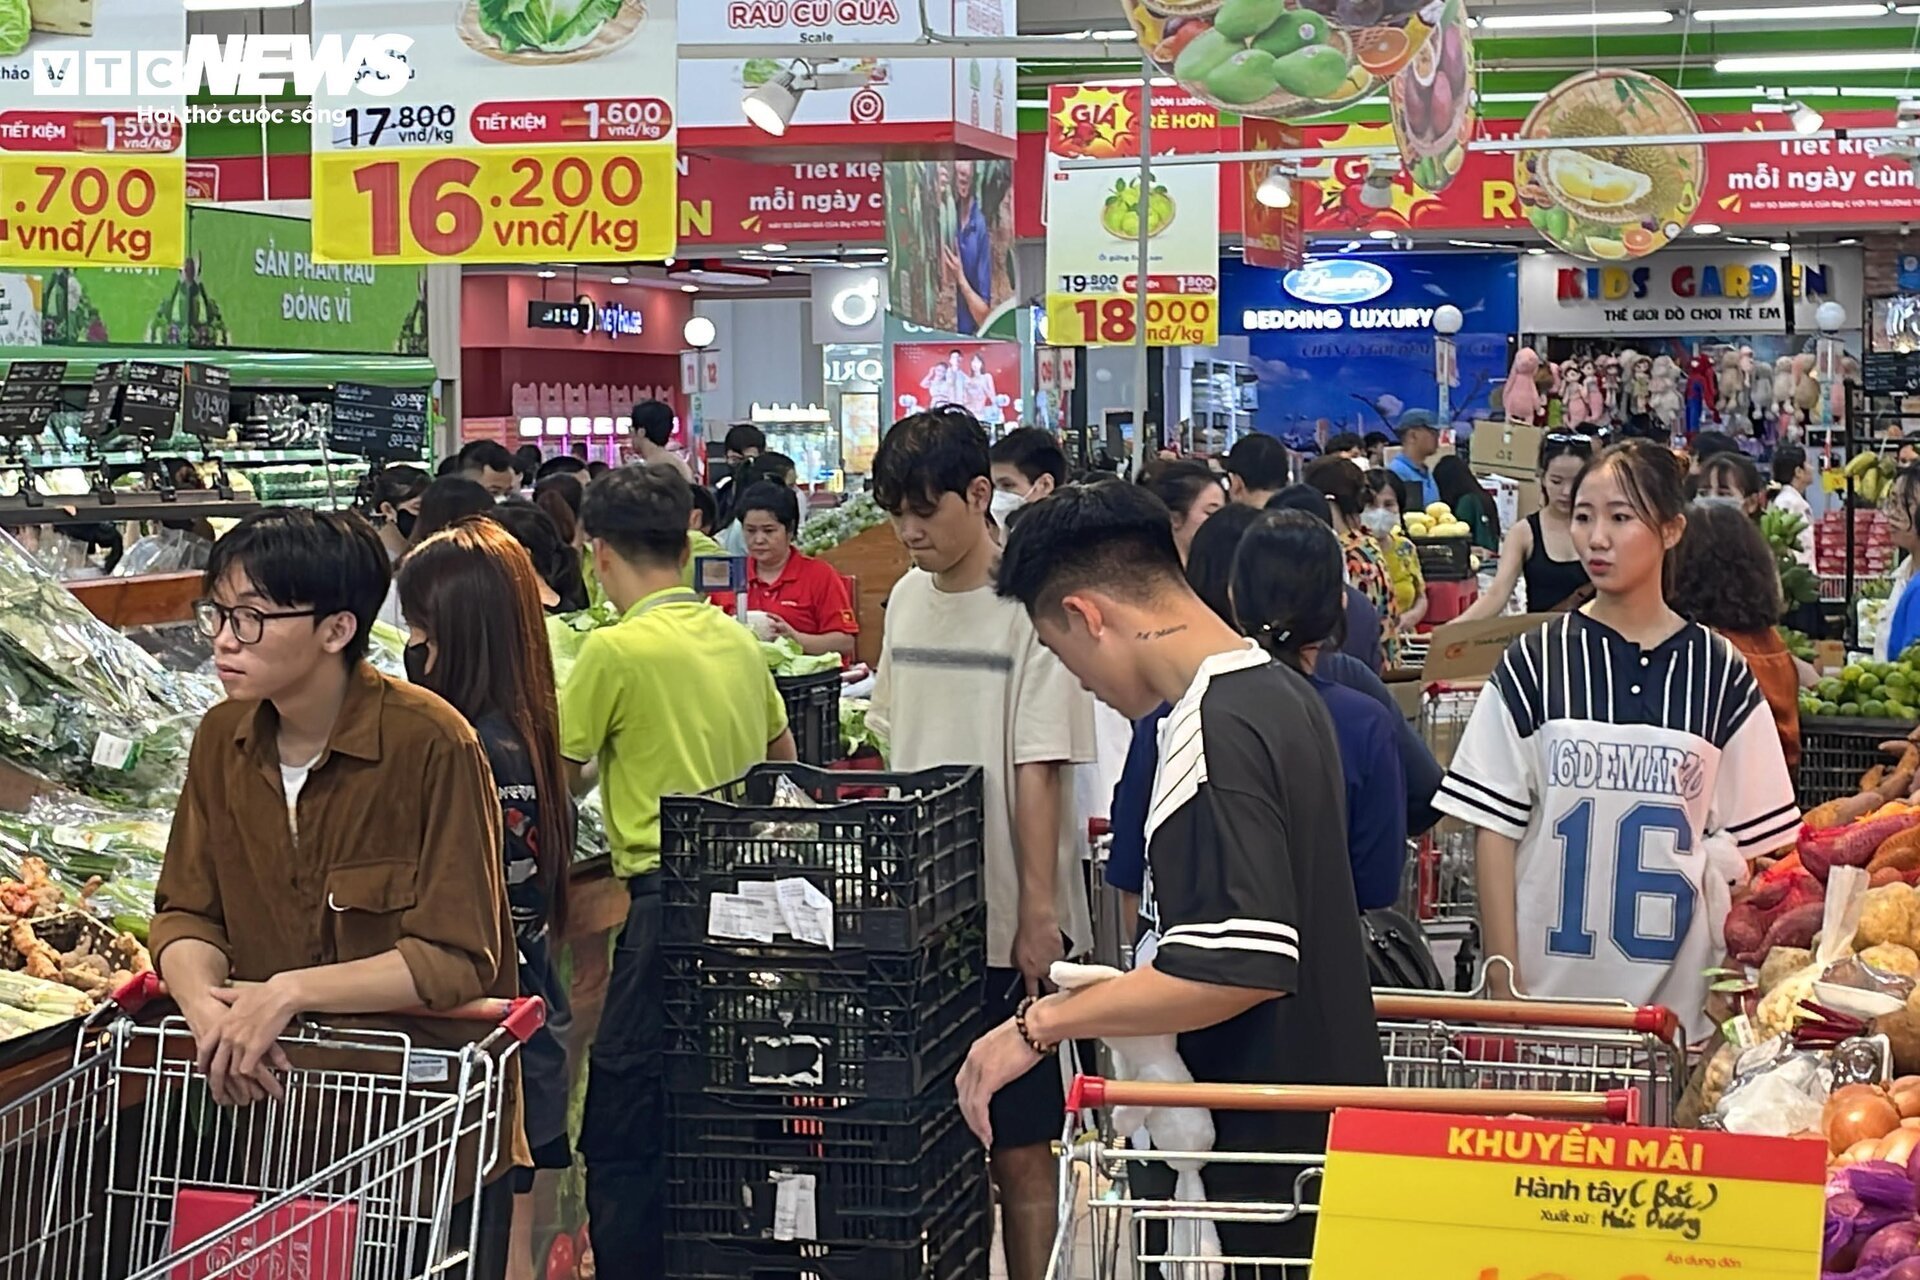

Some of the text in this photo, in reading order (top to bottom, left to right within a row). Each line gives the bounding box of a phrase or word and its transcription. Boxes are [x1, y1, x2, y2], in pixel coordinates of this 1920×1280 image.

[800, 32, 834, 43] Scale
[1151, 96, 1174, 107] UÔN
[345, 104, 456, 147] 17.800
[476, 102, 663, 140] TIẾT KIỆM 1.600
[1071, 103, 1117, 130] GIÁ
[1172, 112, 1215, 129] HƠN
[1, 116, 173, 151] TIẾT KIỆM 1.500
[123, 136, 174, 151] vnđ/kg
[398, 128, 454, 144] vnđ/kg
[607, 125, 661, 138] vnđ/kg
[845, 162, 881, 182] kiệ
[1728, 163, 1914, 192] mỗi ngày cùn
[352, 156, 642, 257] 16.200
[749, 186, 795, 212] mỗi
[801, 189, 861, 213] ngày
[16, 218, 152, 261] vnđ/kg
[493, 210, 639, 253] vnđ/kg
[255, 240, 289, 277] SẢN
[1557, 265, 1650, 300] KIDS
[1242, 308, 1434, 330] BEDDING LUXURY
[1759, 307, 1781, 319] EM
[1146, 325, 1204, 344] nđ/kg
[1545, 797, 1698, 965] 16
[1448, 1124, 1704, 1172] KHUYẾN MÃI
[1514, 1176, 1627, 1209] Hành tây
